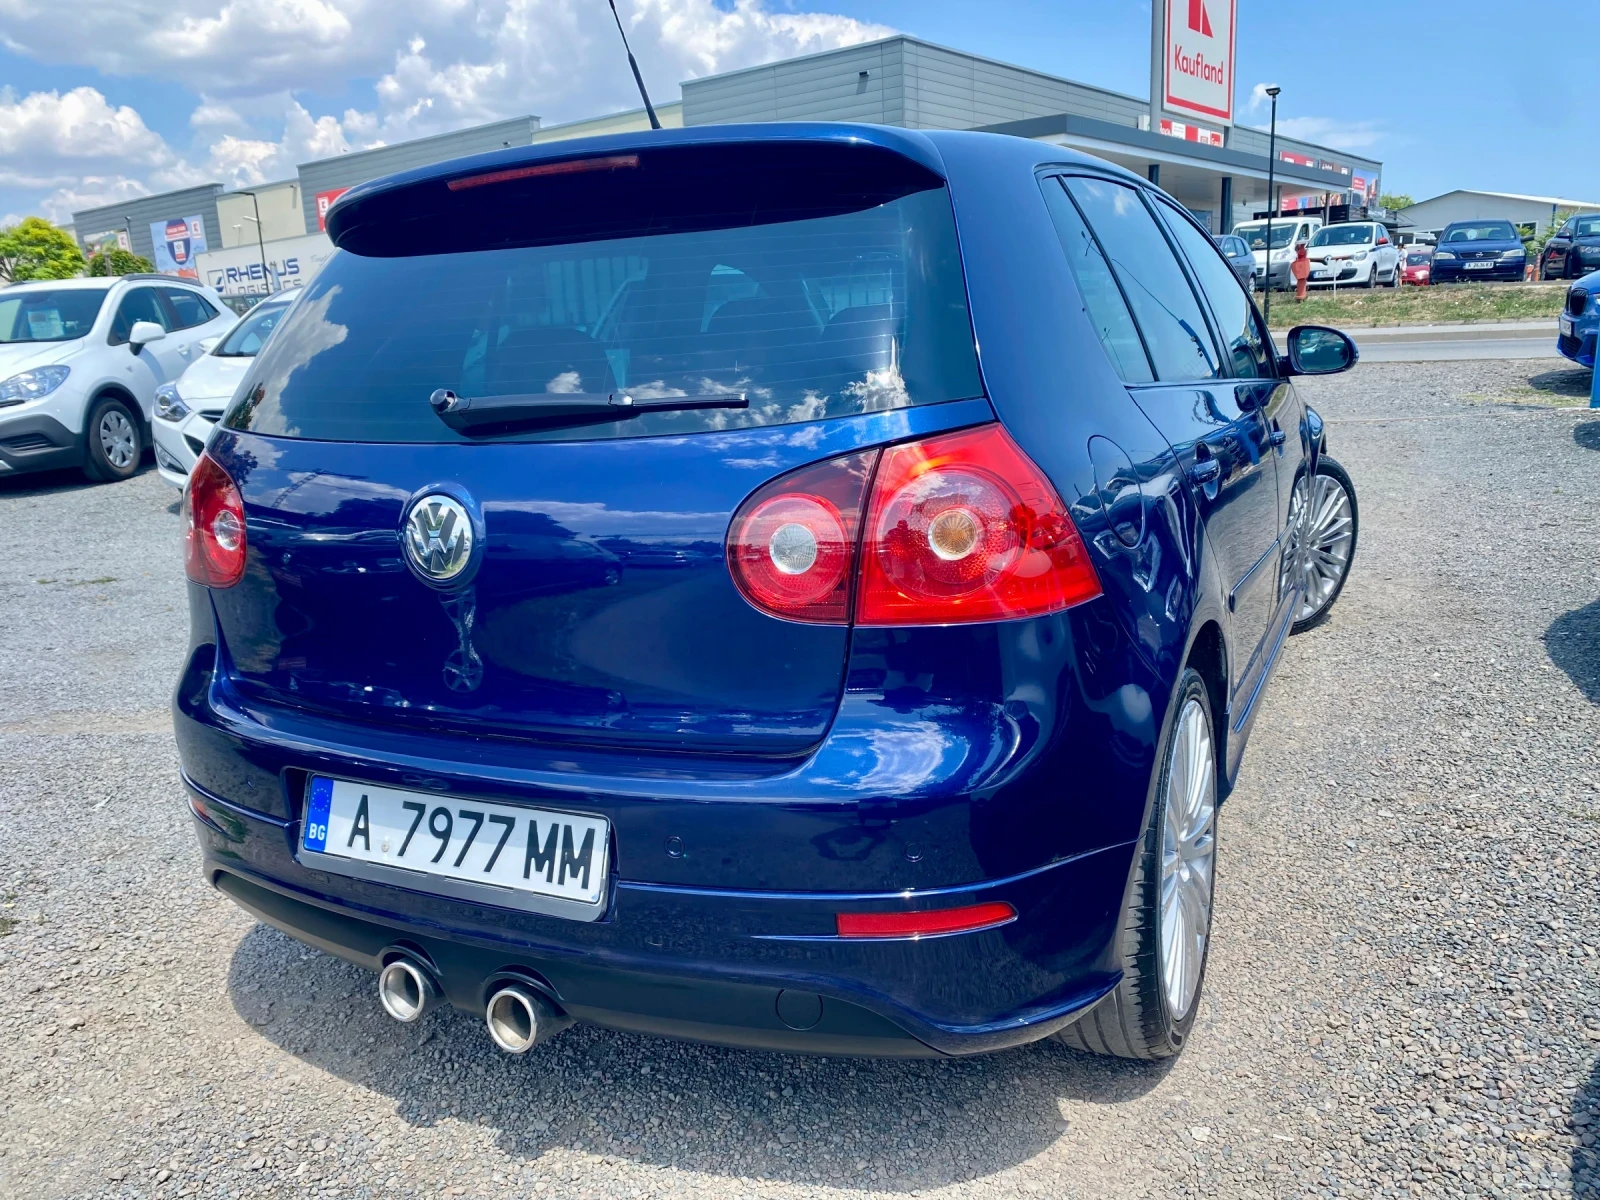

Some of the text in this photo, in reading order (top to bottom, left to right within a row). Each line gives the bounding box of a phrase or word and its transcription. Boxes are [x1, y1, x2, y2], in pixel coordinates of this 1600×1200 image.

[1174, 43, 1224, 85] Kaufland
[225, 257, 300, 284] RHENUS
[229, 278, 302, 295] LOGISCS
[308, 822, 326, 841] BG
[347, 794, 595, 890] A 7977 MM
